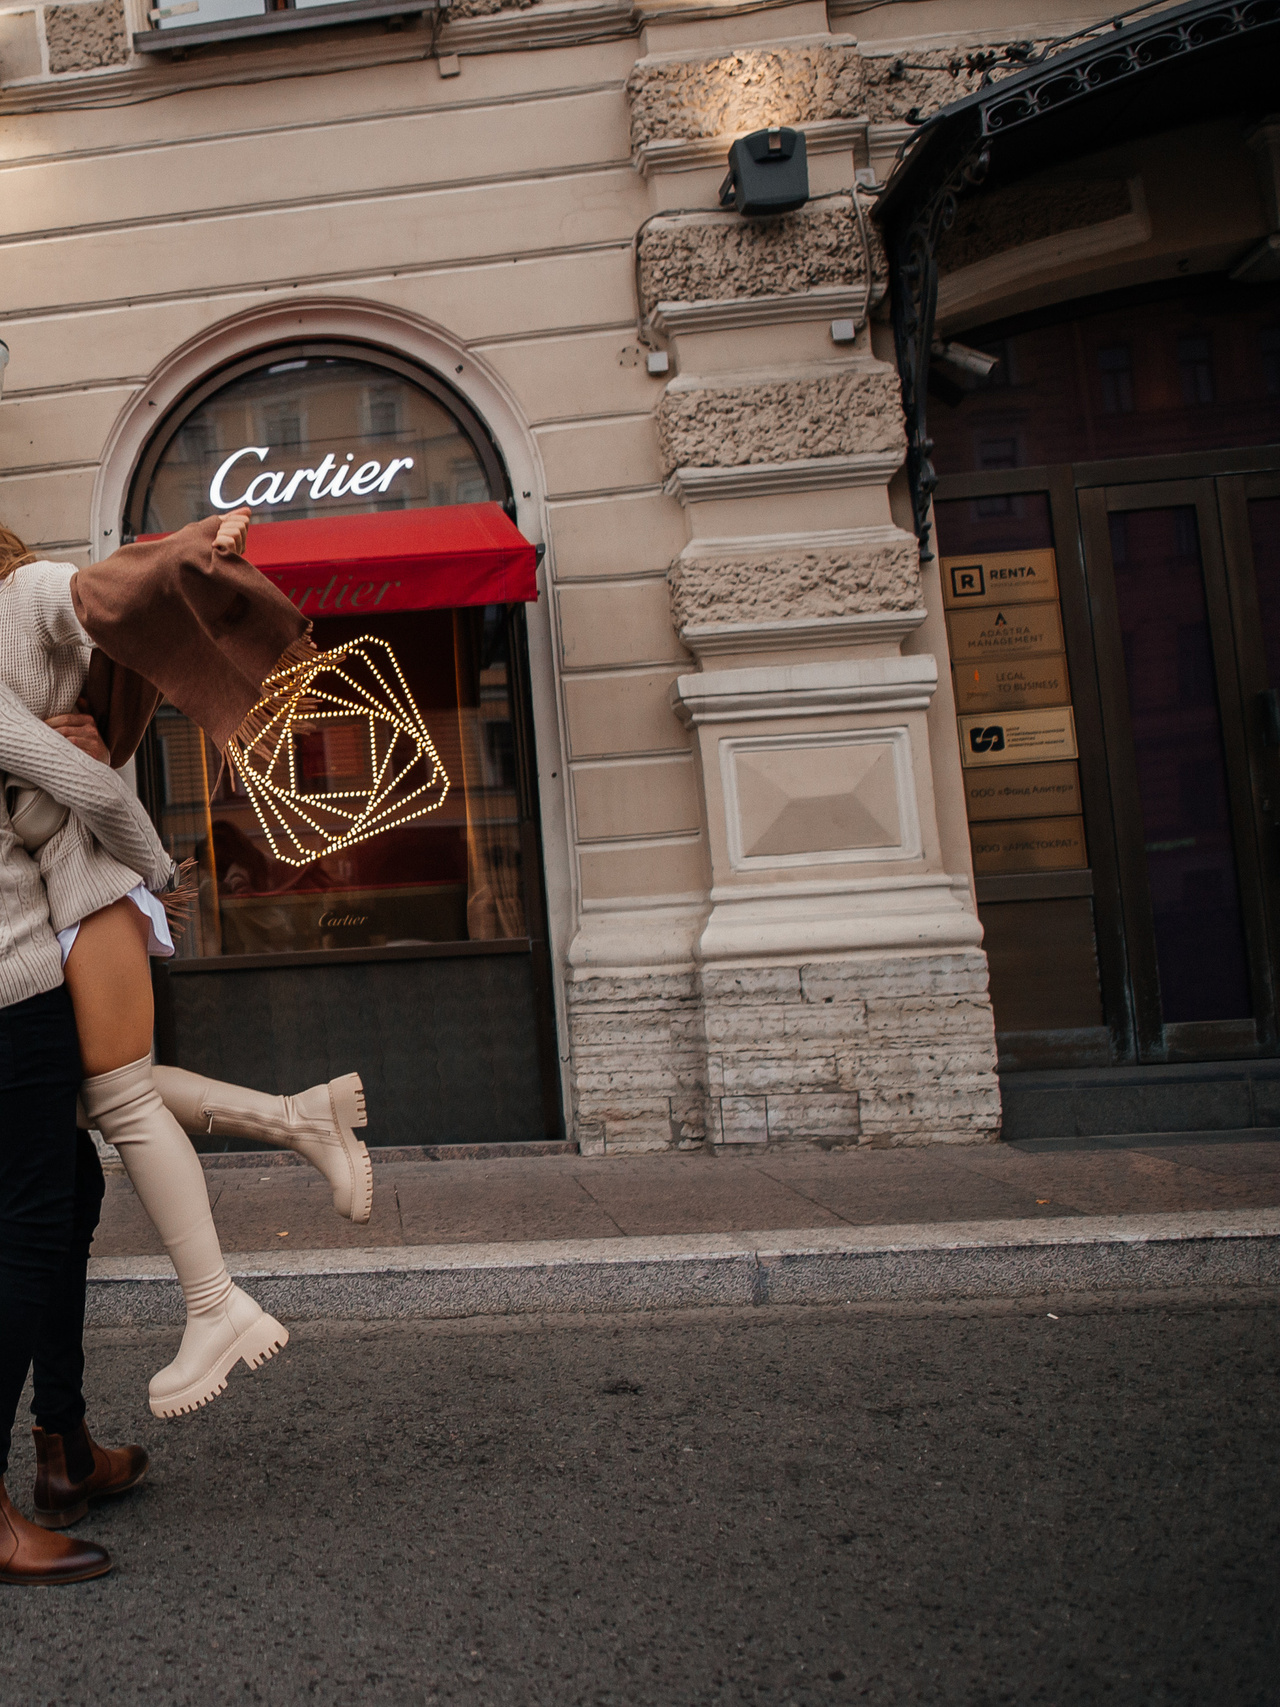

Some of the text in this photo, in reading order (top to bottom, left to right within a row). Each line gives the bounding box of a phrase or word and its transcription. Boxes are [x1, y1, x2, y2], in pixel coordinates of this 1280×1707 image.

[209, 446, 414, 510] Cartier
[990, 567, 1036, 580] RENTA
[961, 574, 975, 589] R
[265, 573, 402, 610] rtier
[980, 626, 1030, 638] ADASTRA
[968, 634, 1044, 648] MANAGEMENT
[995, 672, 1025, 682] LEGAL
[998, 680, 1059, 692] TO BUSINESS
[971, 787, 996, 798] ООО
[318, 912, 369, 928] Cartier
